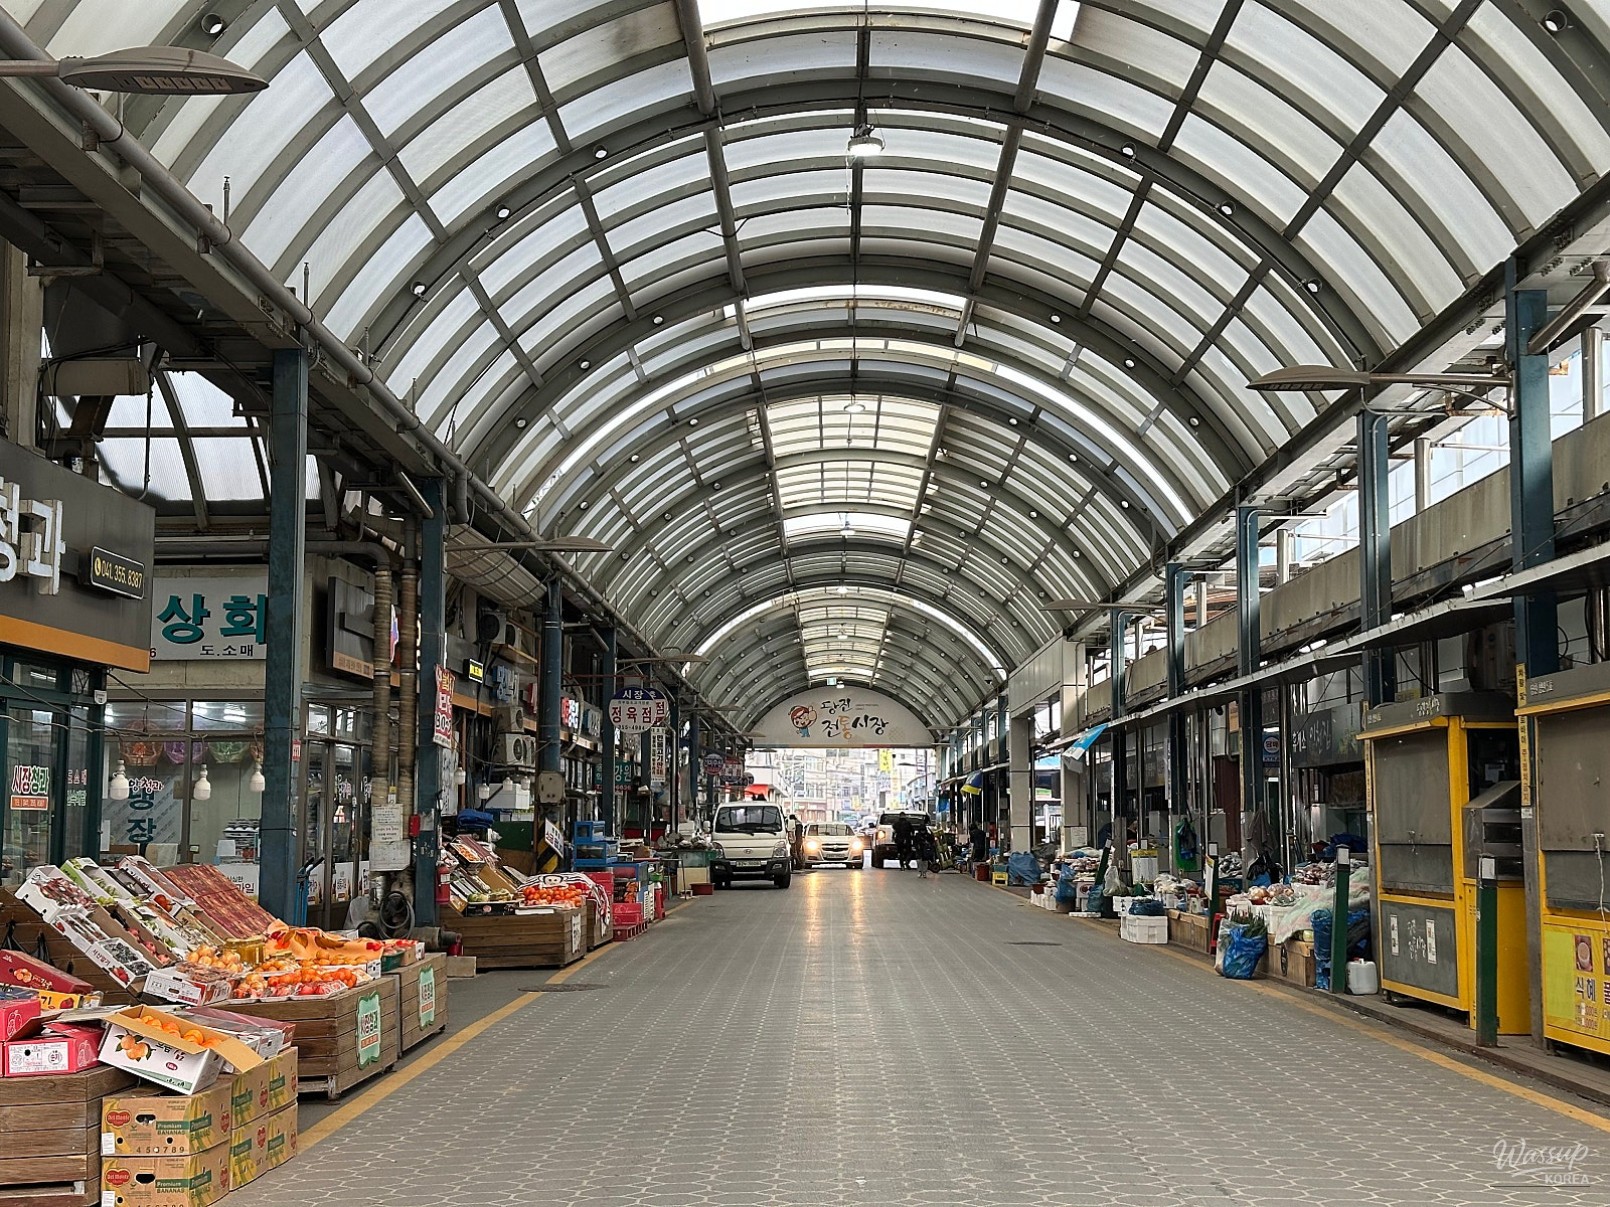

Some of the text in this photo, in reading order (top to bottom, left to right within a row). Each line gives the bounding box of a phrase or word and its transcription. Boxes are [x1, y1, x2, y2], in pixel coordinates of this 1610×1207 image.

[157, 593, 268, 644] 상회
[622, 689, 645, 700] 시장
[820, 698, 852, 715] 당진
[611, 706, 652, 723] 정육점
[821, 715, 889, 740] 전통시장
[11, 764, 50, 795] 시장청과
[1575, 976, 1596, 1003] 식혜
